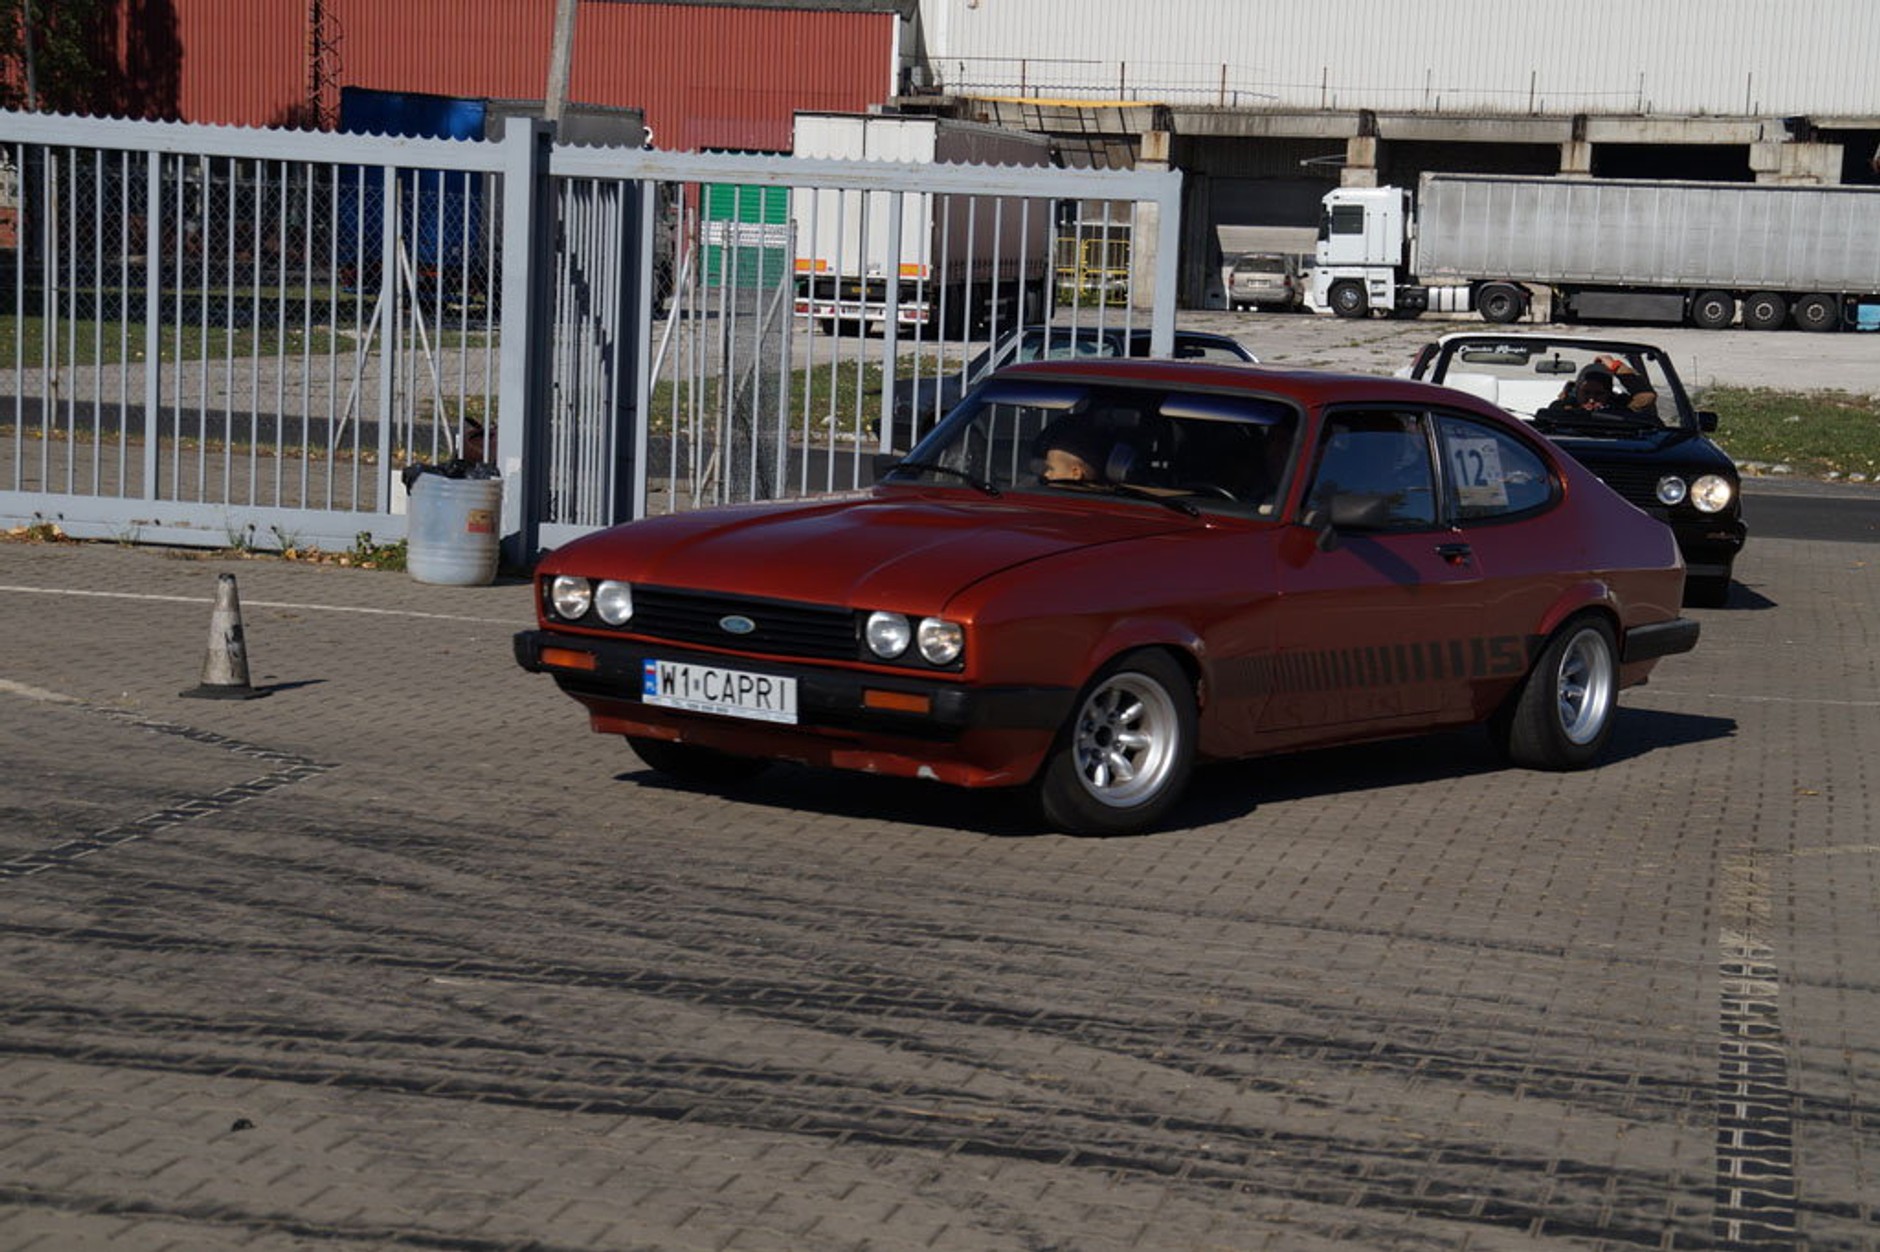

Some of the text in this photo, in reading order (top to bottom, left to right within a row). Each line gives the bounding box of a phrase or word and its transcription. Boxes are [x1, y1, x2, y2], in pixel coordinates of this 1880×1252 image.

[1455, 449, 1489, 487] 12
[660, 664, 786, 711] W1 CAPRI
